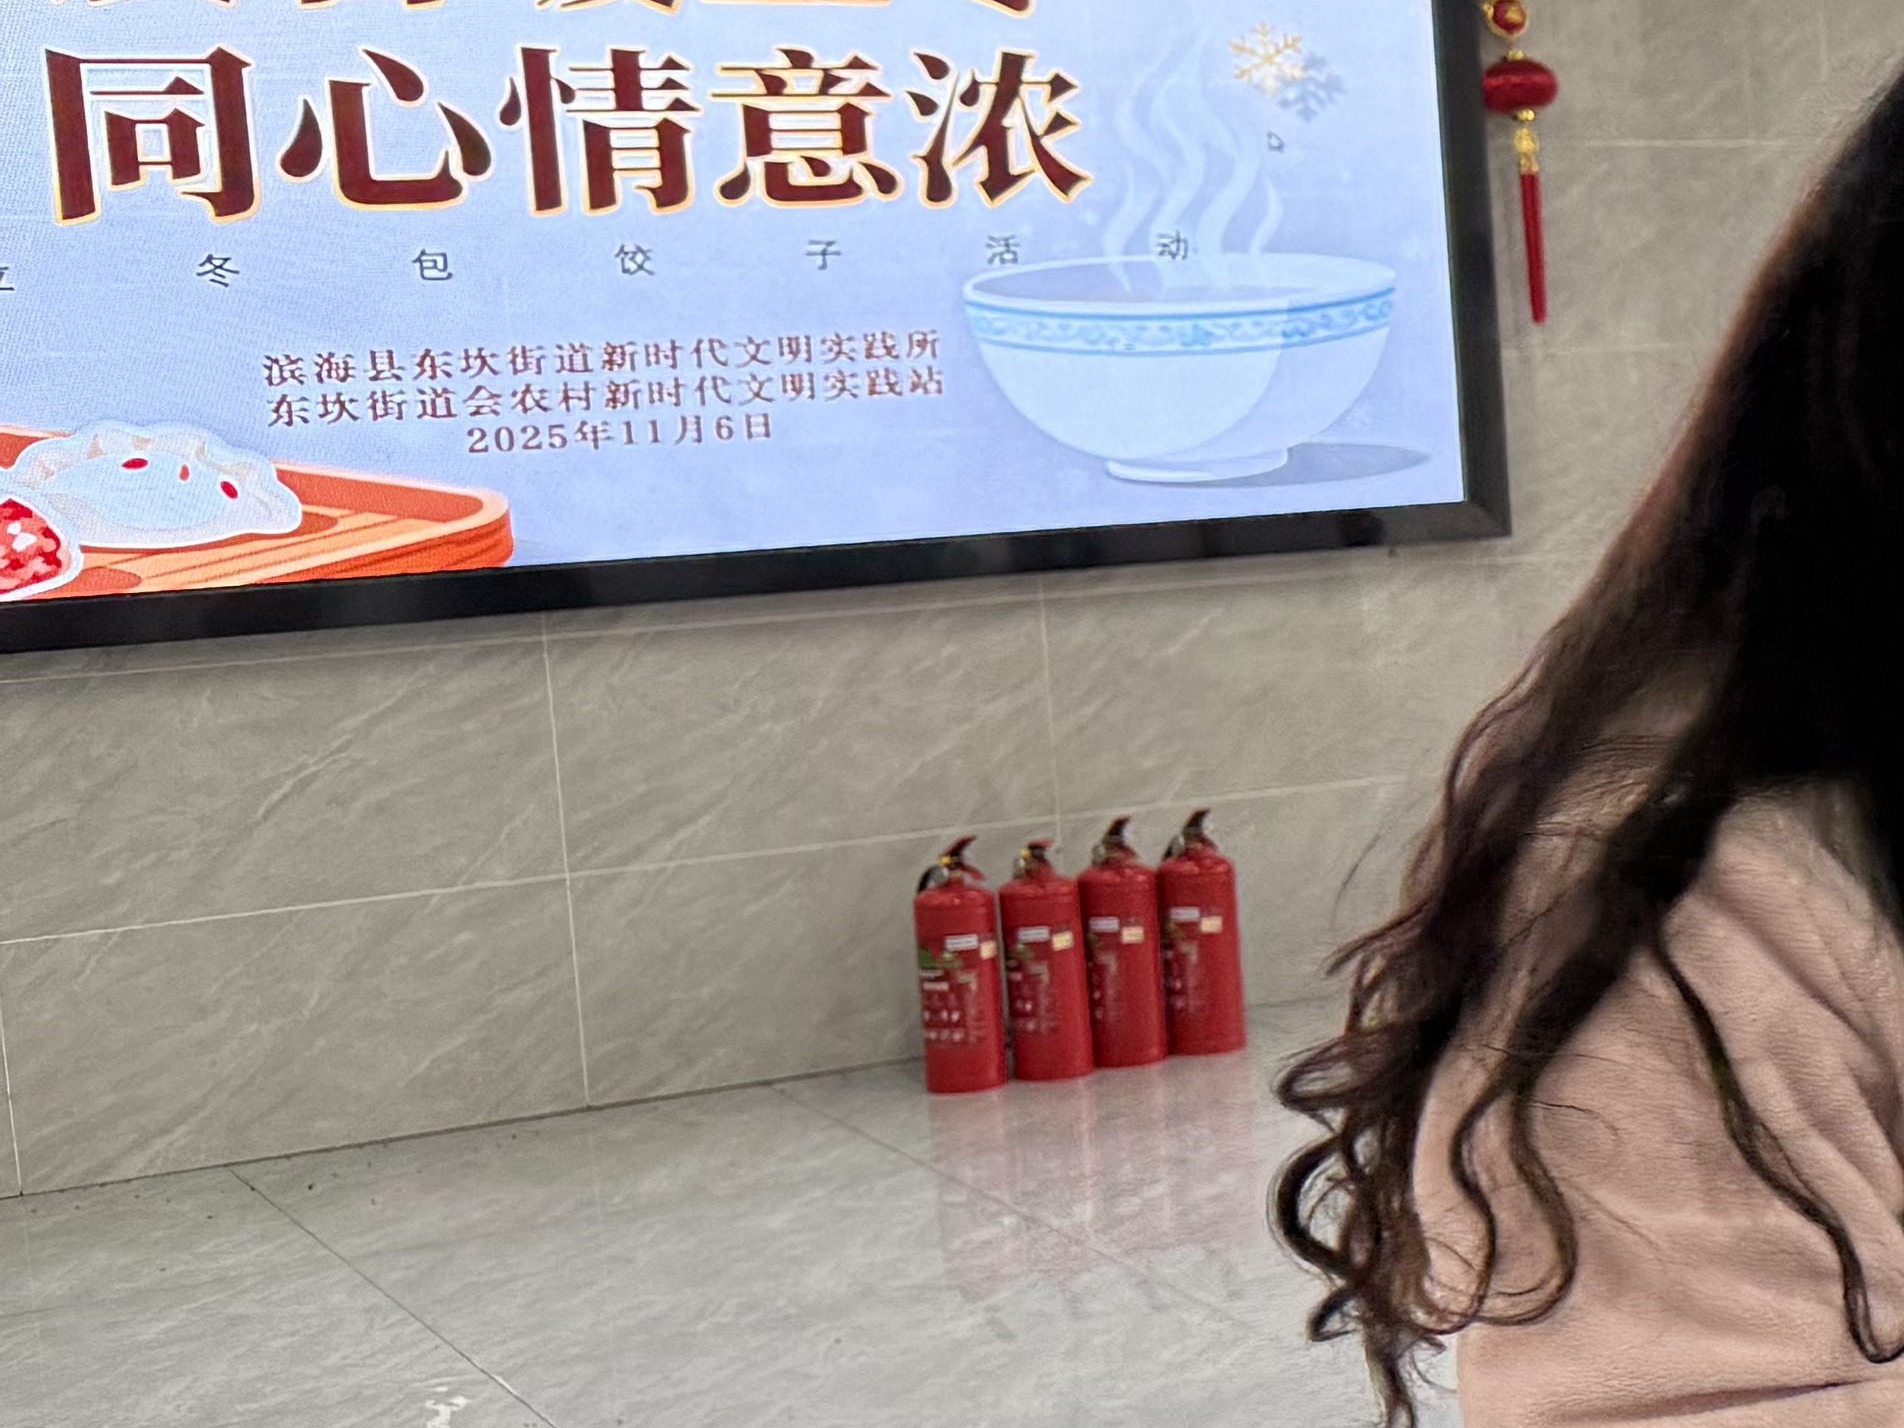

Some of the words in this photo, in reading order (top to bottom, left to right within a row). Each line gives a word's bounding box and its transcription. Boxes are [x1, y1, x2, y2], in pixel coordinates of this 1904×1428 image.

[42, 43, 1095, 226] 同心情意浓
[263, 328, 942, 389] 滨海县东坎街道新时代文明实践所
[266, 366, 946, 429] 东坎街道会农村新时代文明实践站
[467, 412, 773, 455] 2025年11月6日
